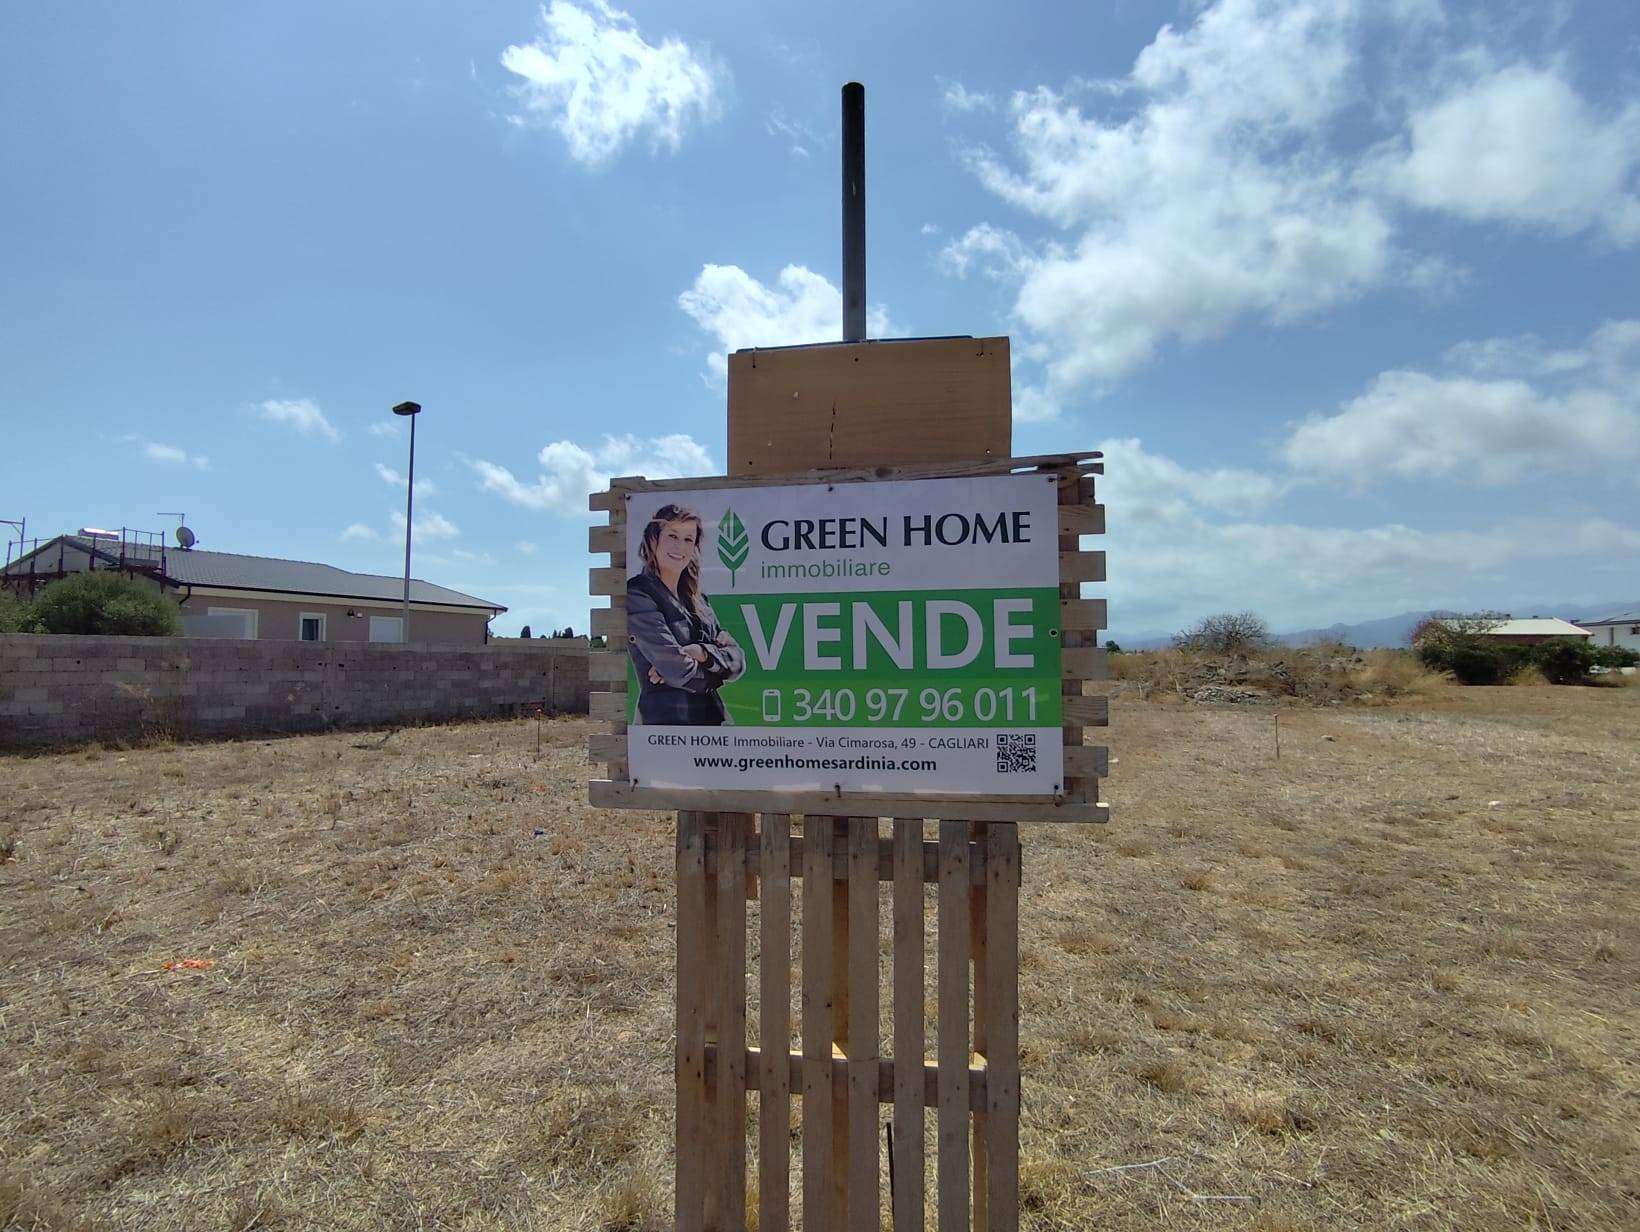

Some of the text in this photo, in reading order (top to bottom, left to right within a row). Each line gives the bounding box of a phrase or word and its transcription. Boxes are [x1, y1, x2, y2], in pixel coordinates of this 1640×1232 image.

[761, 511, 1031, 552] GREEN HOME
[761, 558, 890, 579] immobiliare
[741, 598, 1034, 671] VENDE
[792, 687, 1038, 722] 340 97 96 011
[648, 735, 687, 746] GREEN
[690, 735, 729, 747] HOME
[734, 736, 805, 748] Immobiliare
[816, 737, 836, 749] Via
[839, 737, 899, 751] Cimarosa,
[901, 738, 917, 749] 49
[929, 738, 989, 750] CAGLIARI
[694, 755, 936, 771] www.greenhomesardinia.com
